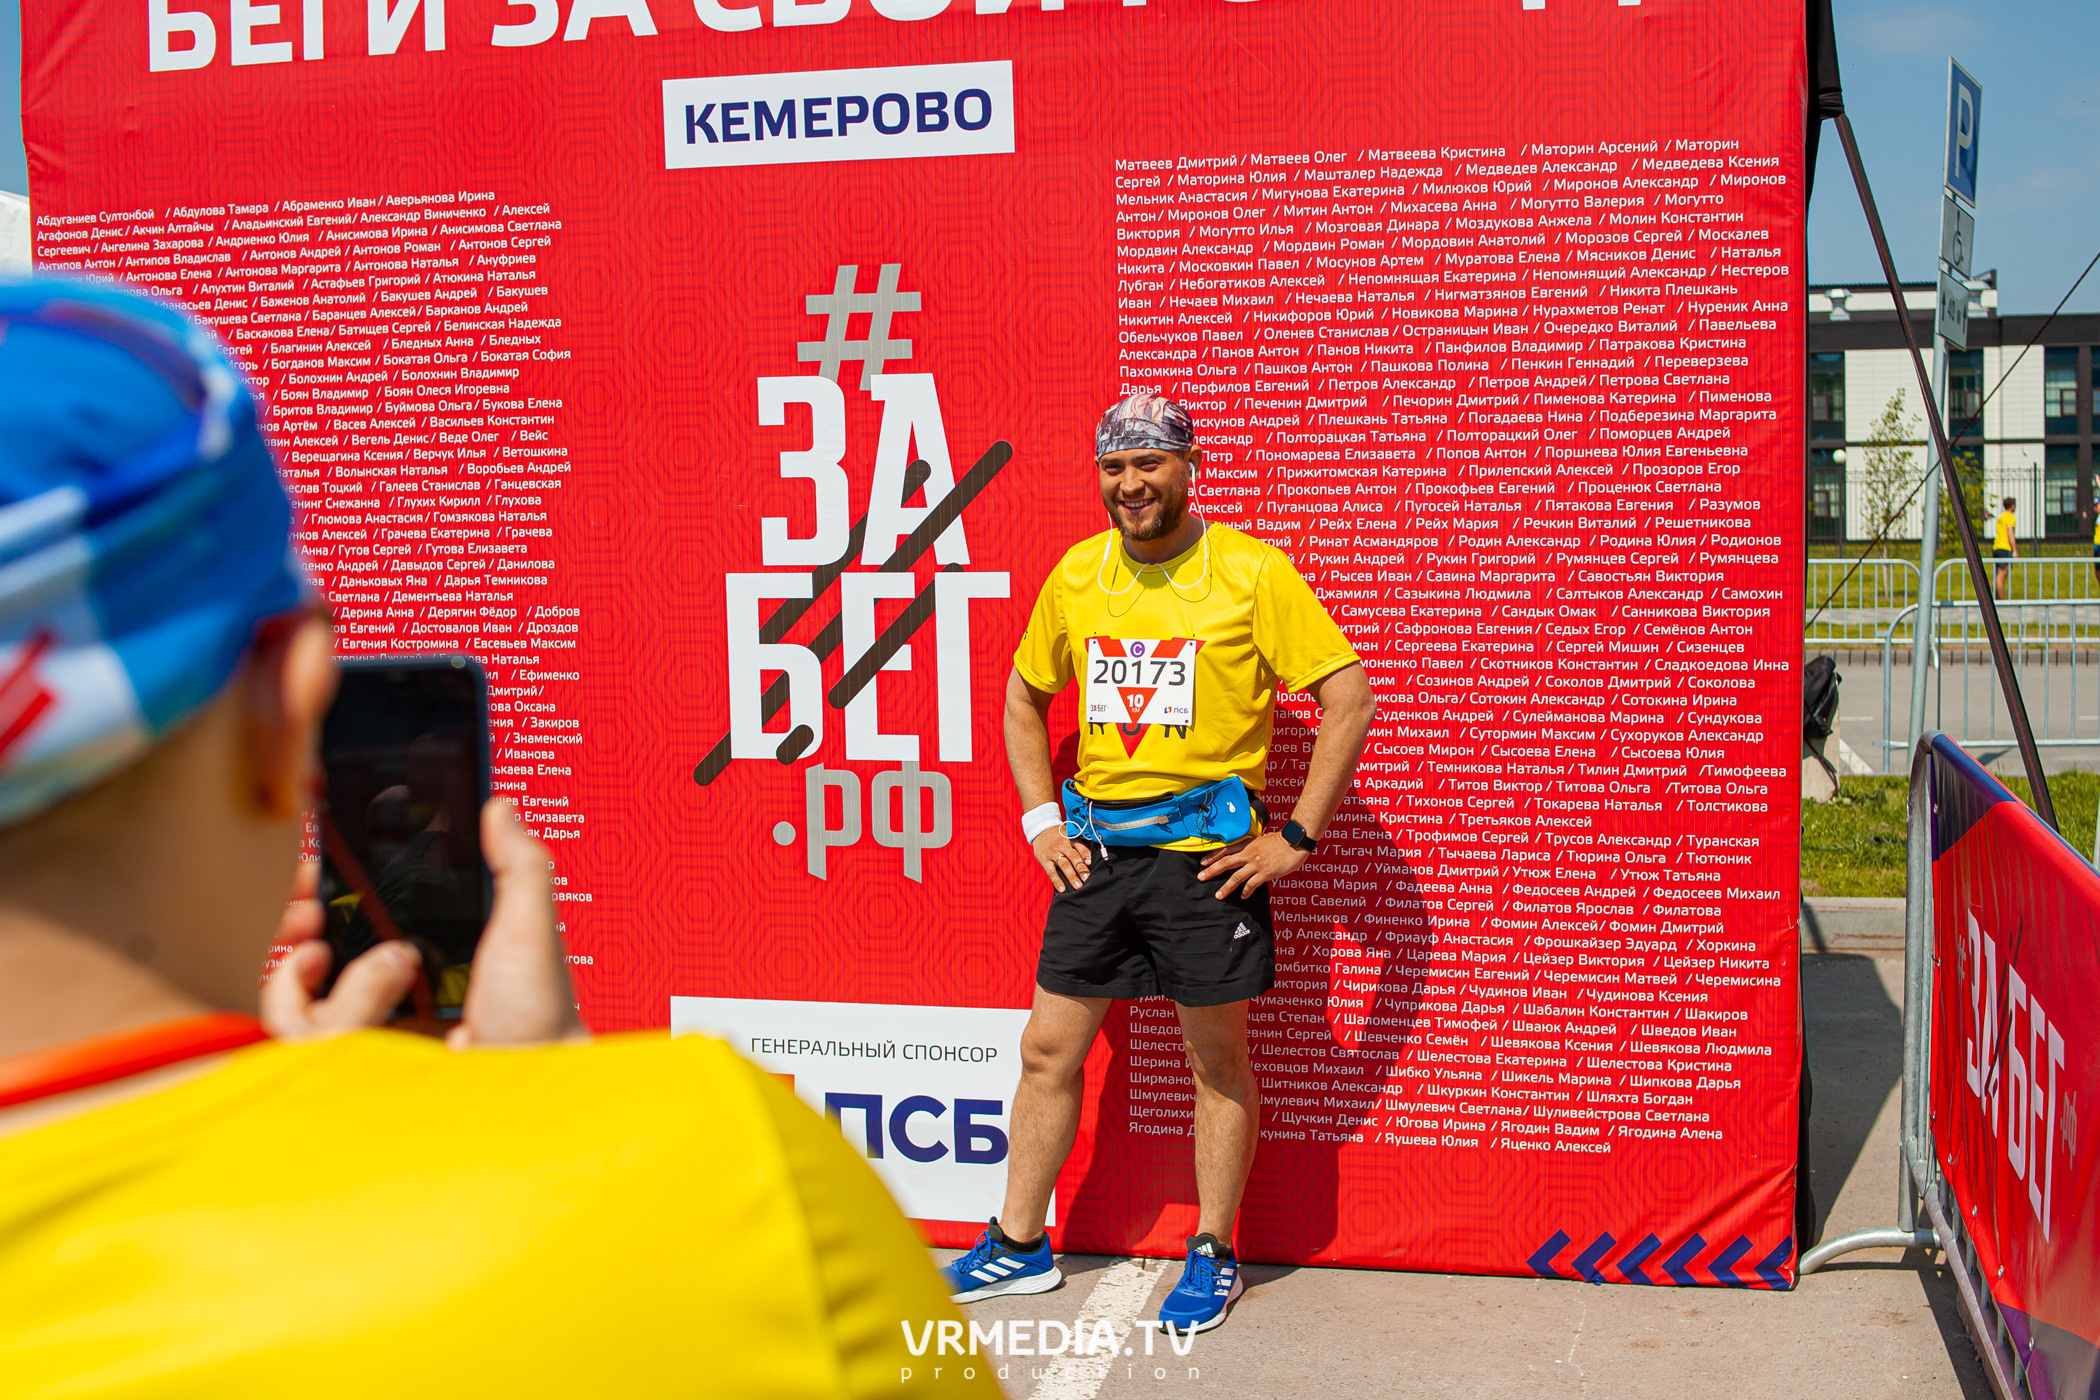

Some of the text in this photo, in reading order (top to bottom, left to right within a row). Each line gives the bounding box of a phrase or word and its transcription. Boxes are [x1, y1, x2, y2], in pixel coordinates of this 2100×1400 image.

[684, 88, 994, 144] КЕМЕРОВО
[1115, 139, 1739, 171] Матвеев Дмитрий Матвеев Олег Матвеева Кристина Маторин Арсений Маторин
[1116, 174, 1786, 206] Мельник Анастасия Мигунова Екатерина Милюков Юрий Миронов Александр Миронов
[36, 190, 495, 227] Абдуганиев Султонбой Абдулова Тамара Абраменко Иван Аверьянова Ирина
[37, 220, 562, 258] Сергеевич Ангелина Захарова Андриенко Юлия Анисимова Ирина Анисимова Светлана
[1117, 228, 1769, 260] Мордвин Александр Мордвин Роман Мордовин Анатолий Морозов Сергей Москалев
[194, 301, 528, 327] Бакушева Светлана Баранцев Алексей Барканов Андрей
[1118, 300, 1788, 326] Никитин Алексей Никифоров Юрий Новикова Марина Нурахметов Ренат Нуреник Анна
[292, 446, 568, 464] Верещагина Ксения Верчук Илья Ветошкина
[1256, 445, 1748, 463] Пономарева Елизавета Попов Антон Поршнева Юлия Евгеньевна
[757, 372, 970, 566] ЗА
[311, 510, 547, 525] Глюмова Анастасия Гомзякова Наталья
[340, 605, 580, 620] Дерина Анна Дерягин Фёдор Добров
[1341, 604, 1770, 620] Самусева Екатерина Сандык Омак Санникова Виктория
[342, 638, 576, 651] Евгения Костромина Евсевьев Максим
[520, 669, 580, 683] Ефименко
[726, 571, 1010, 762] БЕГ
[1093, 660, 1186, 686] 20173
[1127, 694, 1144, 708] 10
[513, 732, 583, 744] Знаменский
[1374, 742, 1724, 759] Сысоев Мирон Сысоева Елена Сысоева Юлия
[525, 811, 585, 823] Елизавета
[1352, 828, 1759, 849] Елена Трофимов Сергей Трусов Александр Туранская
[1312, 945, 1770, 970] Хорова Яна Царева Мария Цейзер Виктория Цейзер Никита
[752, 1036, 998, 1064] ГЕНЕРАЛЬНЫЙ СПОНСОР
[1313, 1062, 1741, 1091] Михаил Шибко Ульяна Шикель Марина Шипкова Дарья
[825, 1092, 1008, 1165] ПСБ
[1309, 1129, 1611, 1153] Татьяна Яушева Юлия Яценко Алексей
